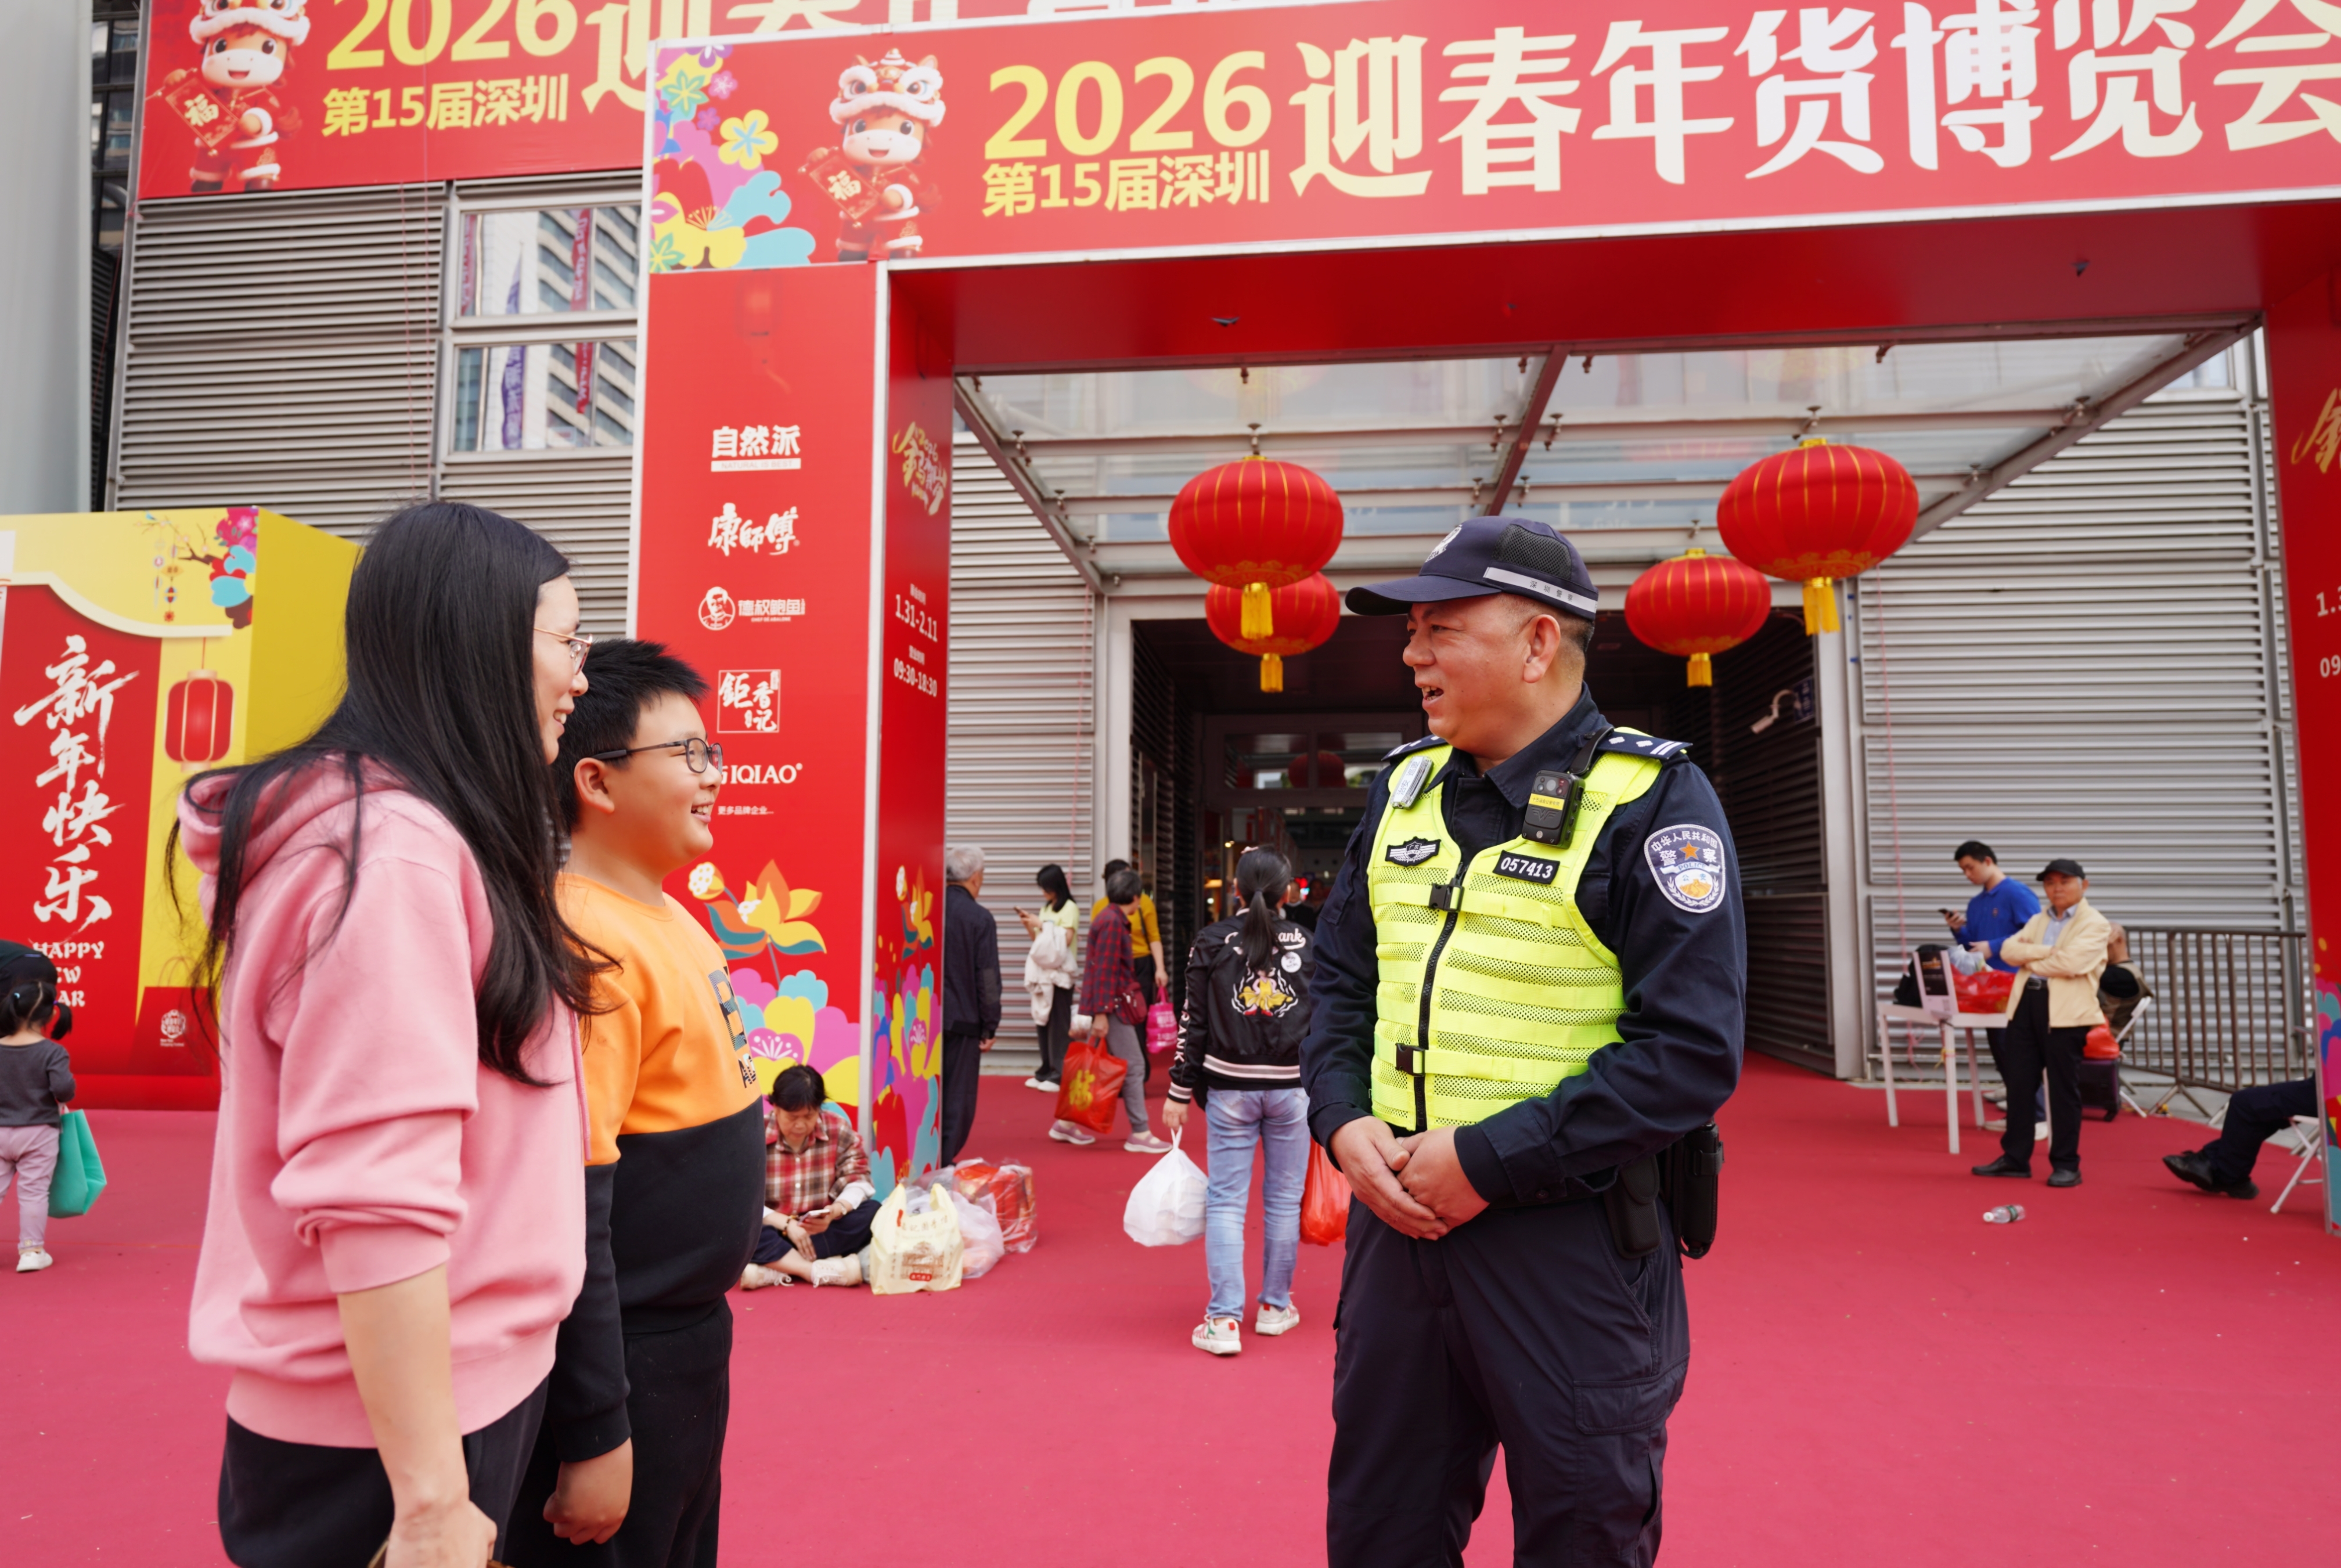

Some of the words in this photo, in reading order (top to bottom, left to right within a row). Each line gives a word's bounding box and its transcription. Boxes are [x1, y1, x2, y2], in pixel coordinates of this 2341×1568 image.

[327, 0, 577, 70] 2026
[184, 93, 220, 128] 福
[321, 73, 569, 137] 第15届深圳
[984, 50, 1272, 160] 2026
[1288, 0, 2341, 198] 迎春年货博览会
[827, 170, 862, 201] 福
[982, 149, 1270, 217] 第15届深圳
[712, 424, 801, 459] 自然派
[771, 460, 793, 468] BEST
[895, 593, 938, 643] 1.31-2.11
[894, 657, 938, 698] 09:30-18:30
[13, 635, 139, 943] 新年快乐
[1651, 830, 1718, 852] 中华人民共和国
[1500, 856, 1553, 879] 057413
[1677, 862, 1706, 871] POLICE
[33, 940, 105, 959] HAPPY
[57, 990, 85, 1007] AR
